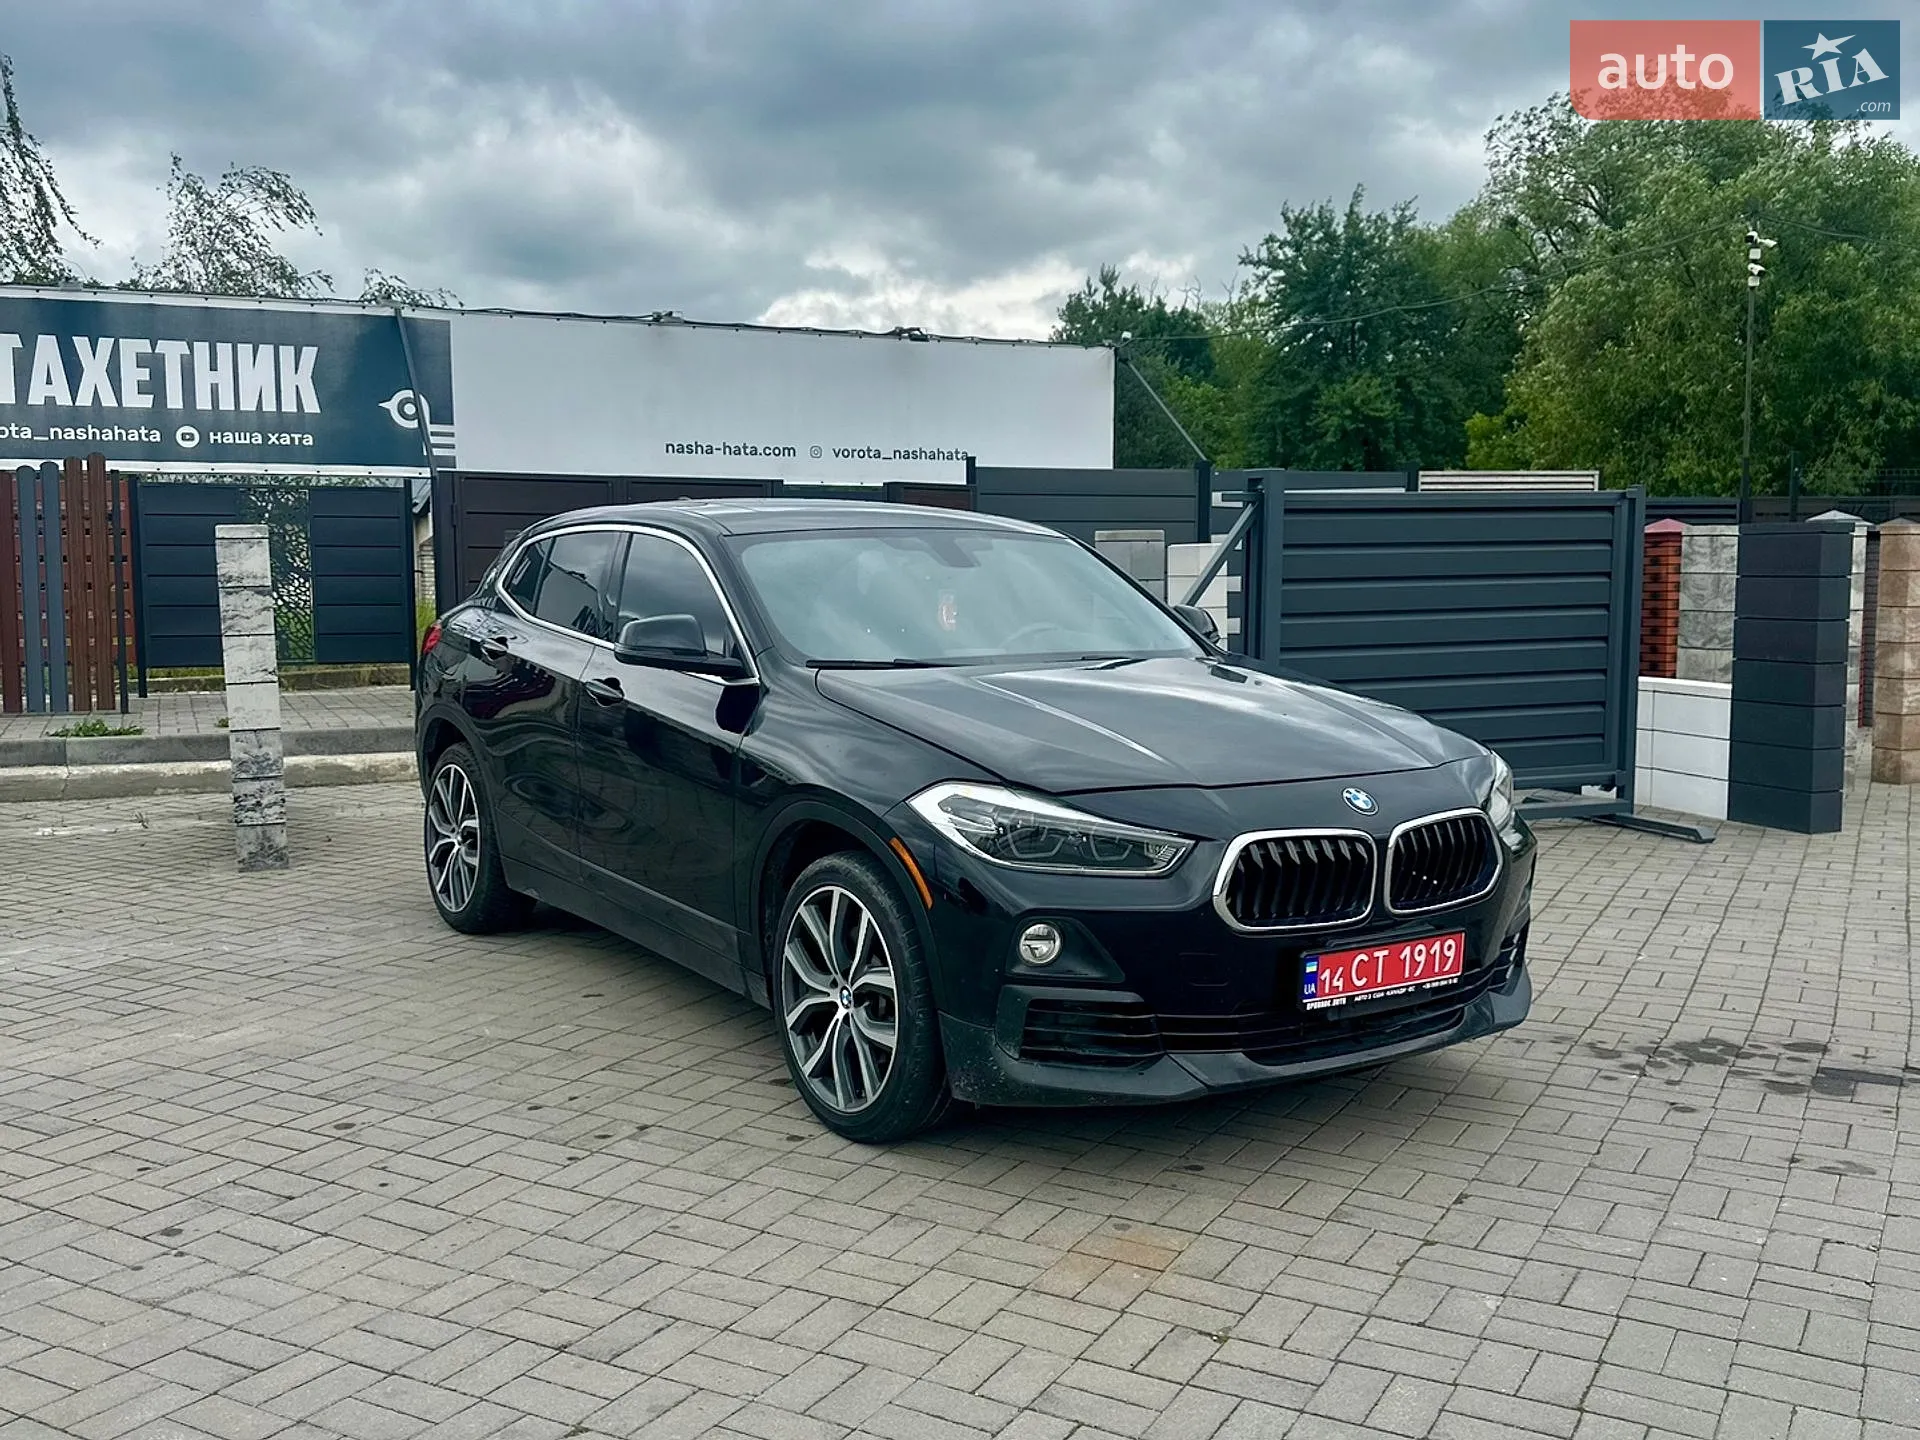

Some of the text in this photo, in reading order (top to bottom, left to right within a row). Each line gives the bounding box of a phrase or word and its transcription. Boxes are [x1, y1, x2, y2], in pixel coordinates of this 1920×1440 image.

[0, 333, 321, 414] ТАХЕТНИК
[209, 431, 314, 446] наша хата
[665, 440, 797, 458] nasha-hata.com
[832, 445, 969, 462] vorota_nashahata
[1399, 938, 1457, 979] 1919
[1303, 982, 1317, 995] UA
